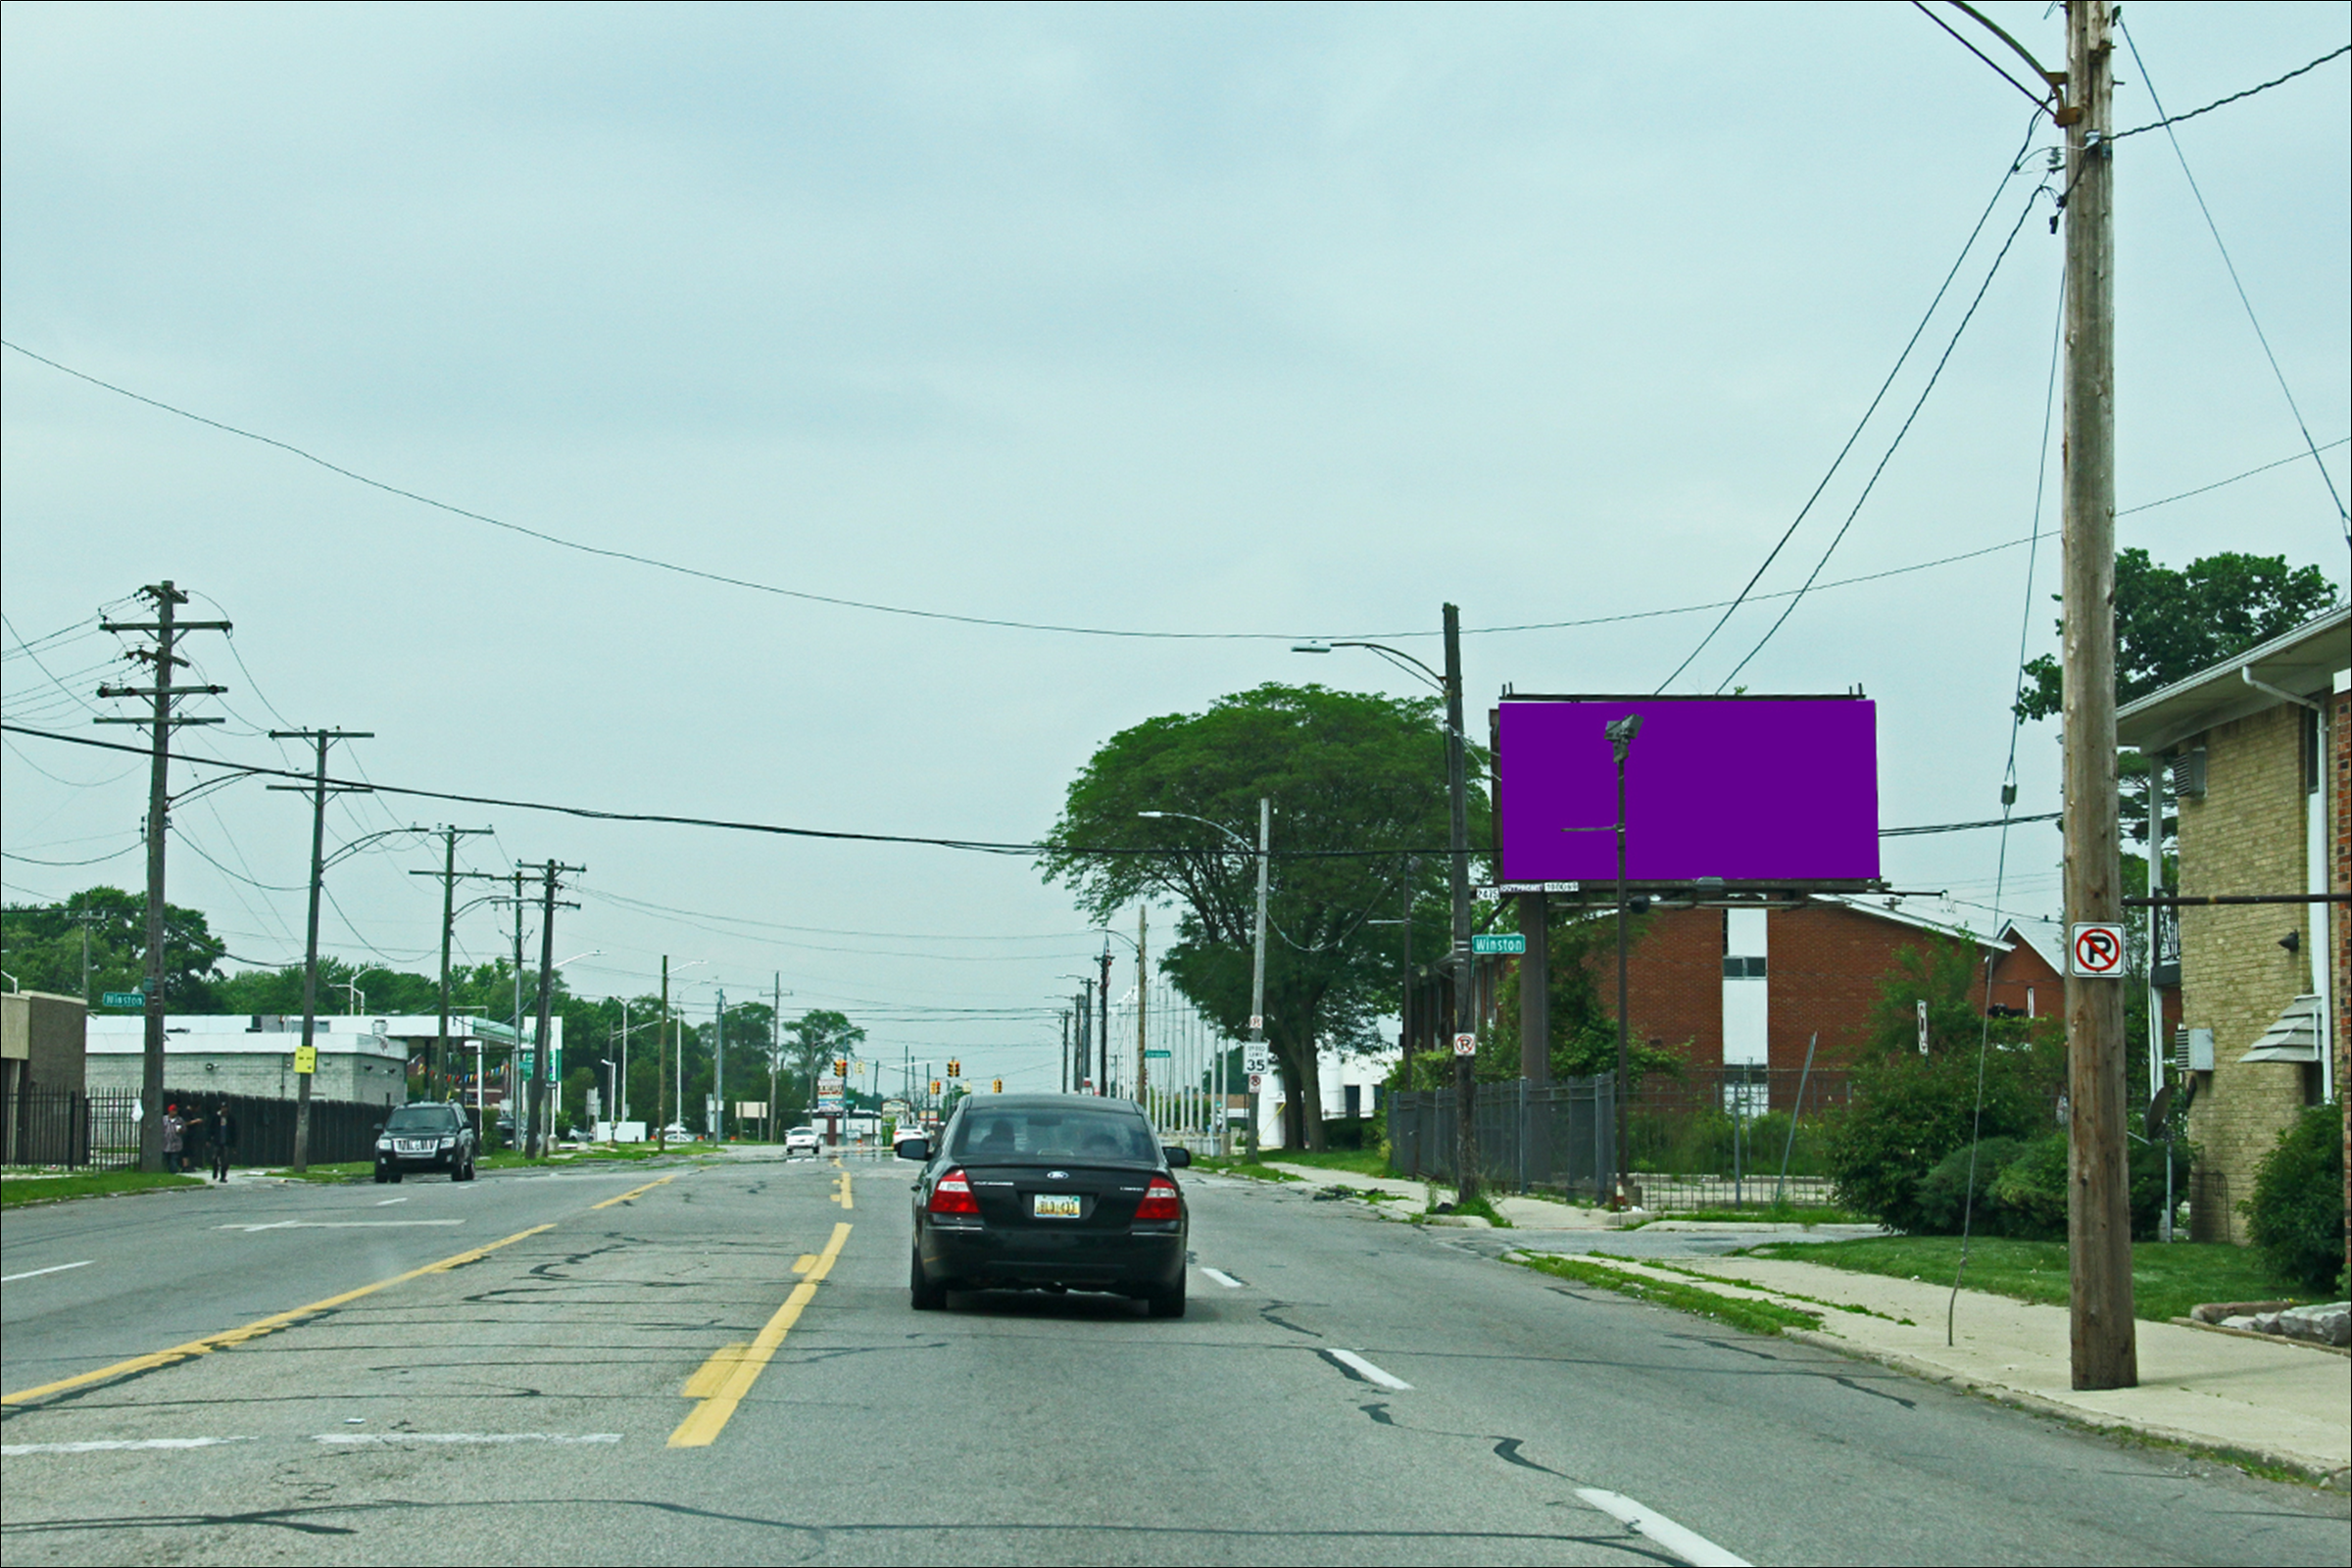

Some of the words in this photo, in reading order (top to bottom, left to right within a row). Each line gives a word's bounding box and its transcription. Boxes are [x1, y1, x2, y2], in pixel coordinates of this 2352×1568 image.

[1476, 937, 1522, 951] Winston
[106, 994, 142, 1005] Winston
[1247, 1059, 1265, 1071] 35
